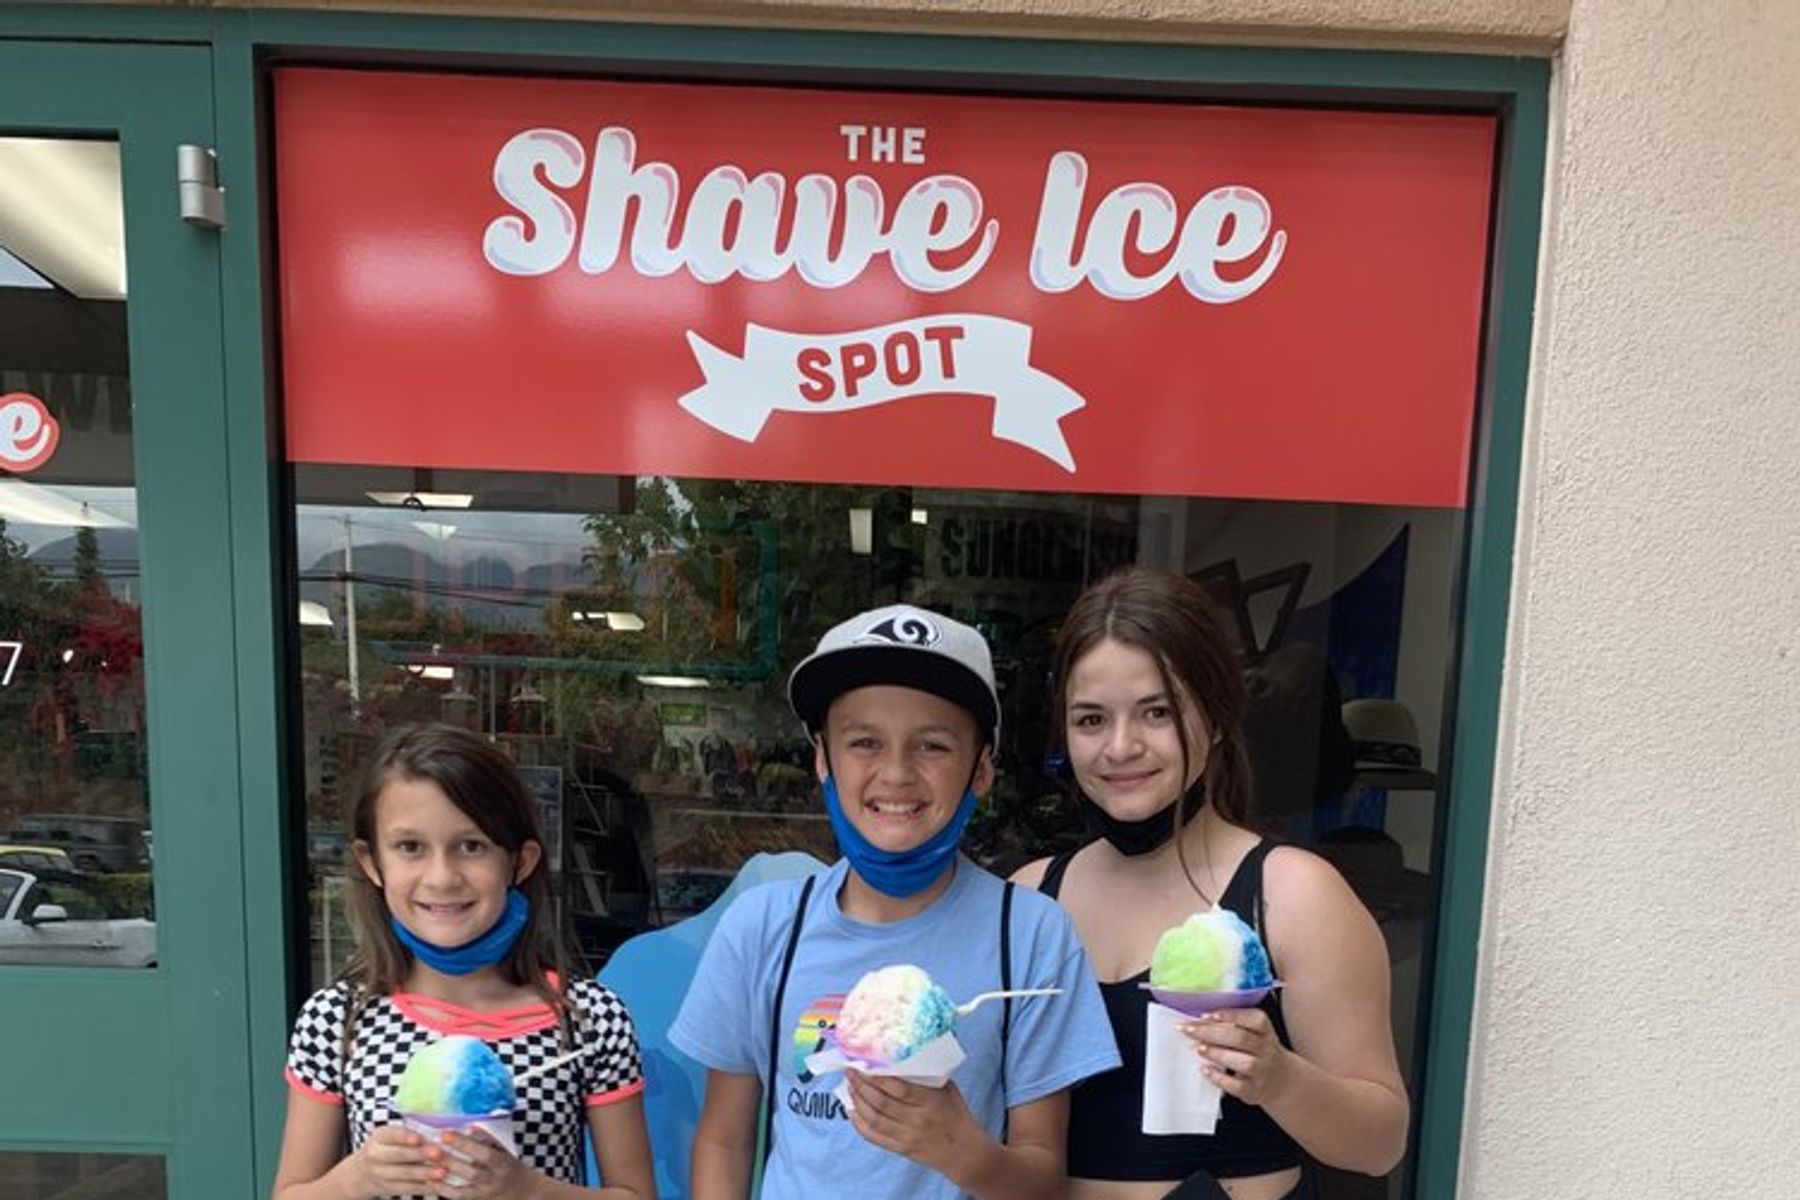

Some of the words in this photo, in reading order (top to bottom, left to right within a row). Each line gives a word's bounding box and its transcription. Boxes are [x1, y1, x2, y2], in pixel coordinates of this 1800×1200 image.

[840, 124, 927, 165] THE
[482, 126, 1000, 292] Shave
[1029, 150, 1288, 303] Ice
[796, 325, 965, 403] SPOT
